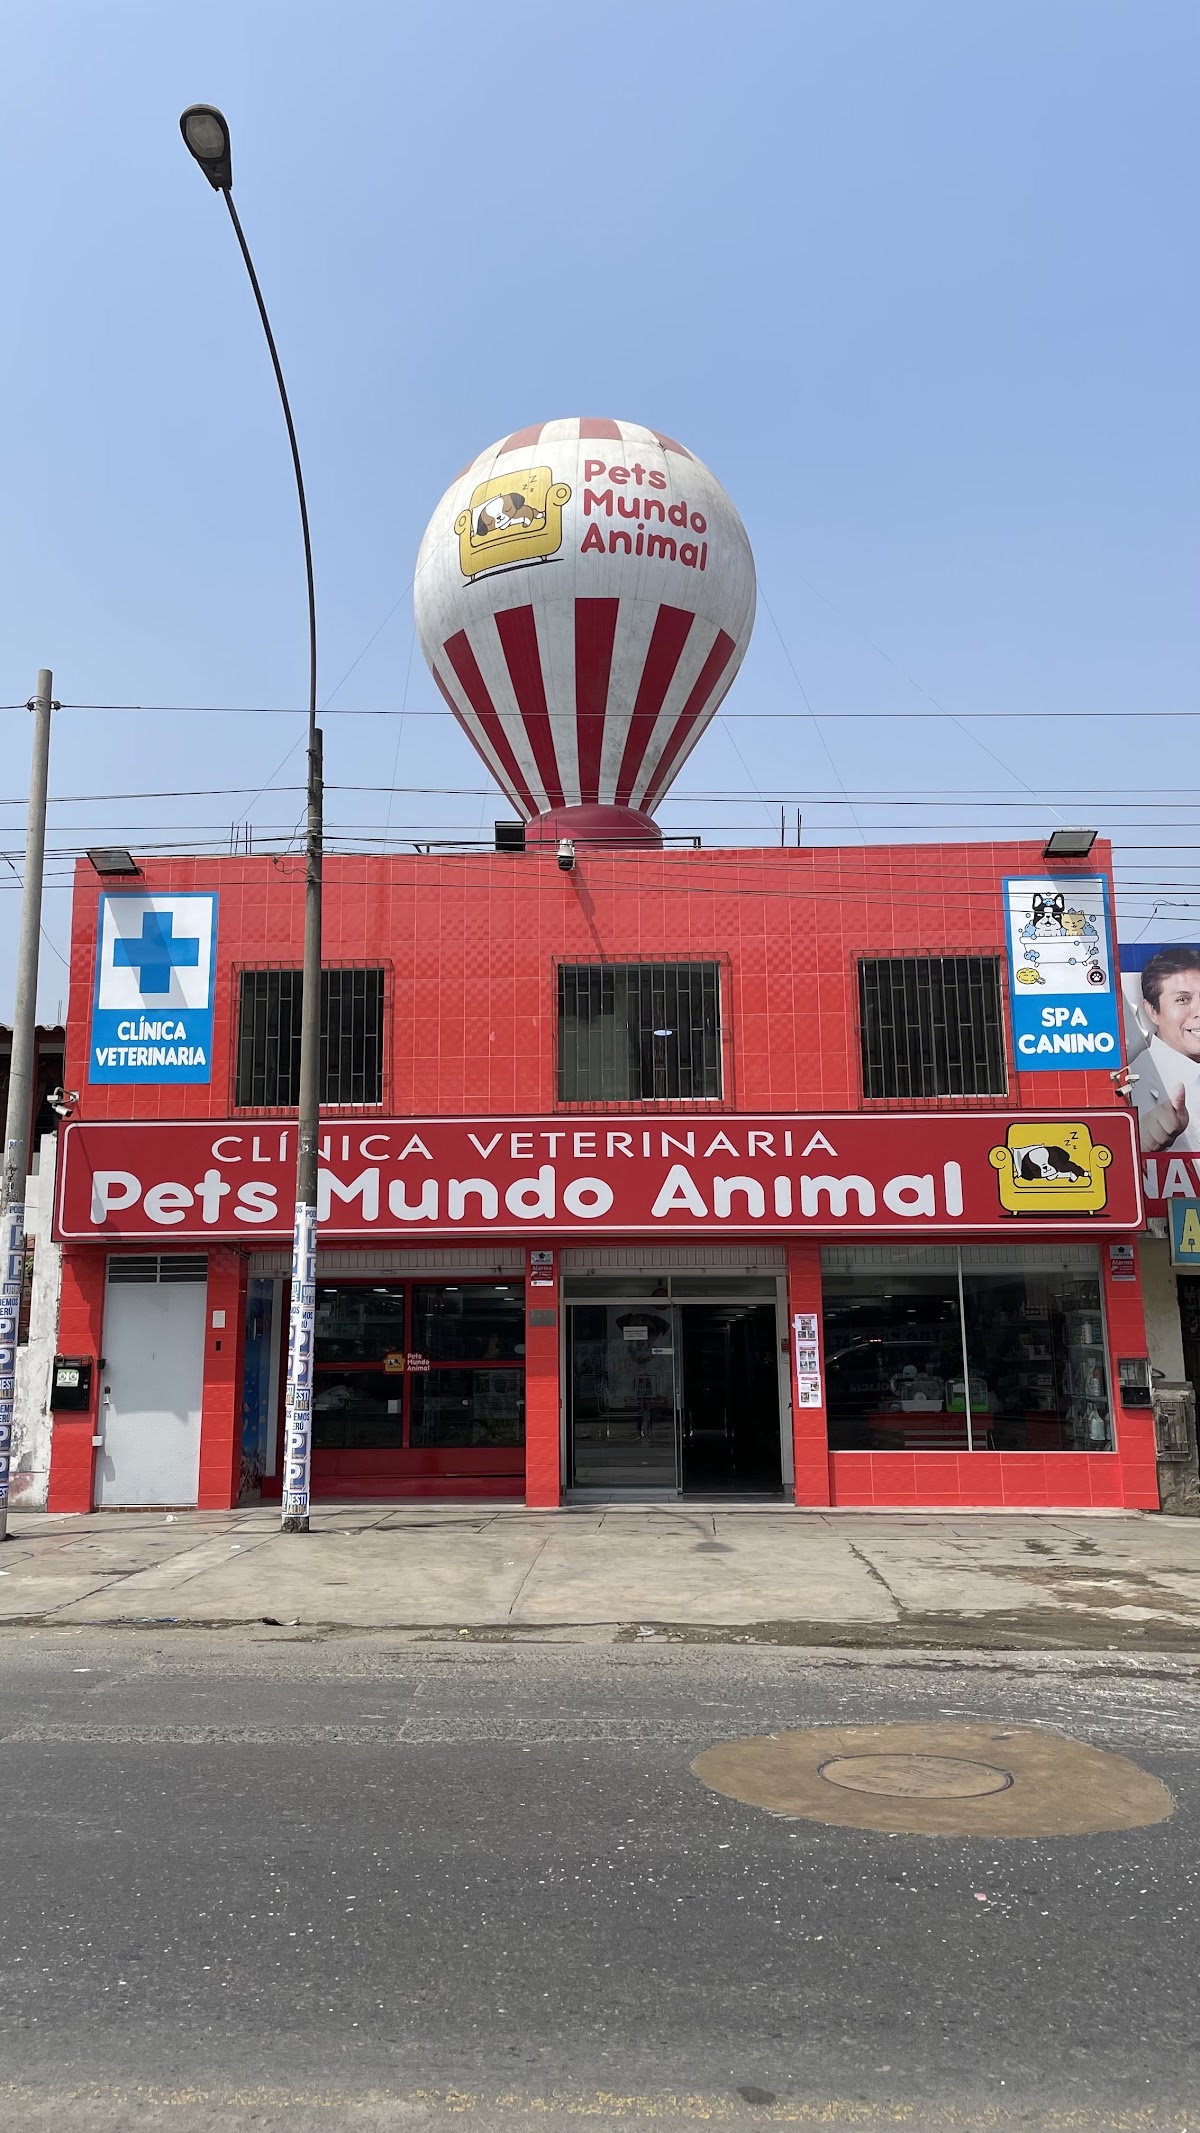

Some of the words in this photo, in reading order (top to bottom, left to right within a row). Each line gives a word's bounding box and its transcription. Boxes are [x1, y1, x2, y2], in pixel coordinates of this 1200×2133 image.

[584, 460, 667, 490] Pets
[583, 488, 707, 533] Mundo
[580, 523, 708, 571] Animal
[117, 1015, 187, 1042] CLÍNICA
[1041, 1006, 1088, 1028] SPA
[95, 1046, 207, 1067] VETERINARIA
[1018, 1032, 1115, 1054] CANINO
[467, 1129, 840, 1160] VETERINARIA
[88, 1168, 279, 1225] Pets
[316, 1164, 614, 1223] Mundo
[652, 1160, 965, 1218] Animal
[1142, 1158, 1200, 1199] NA
